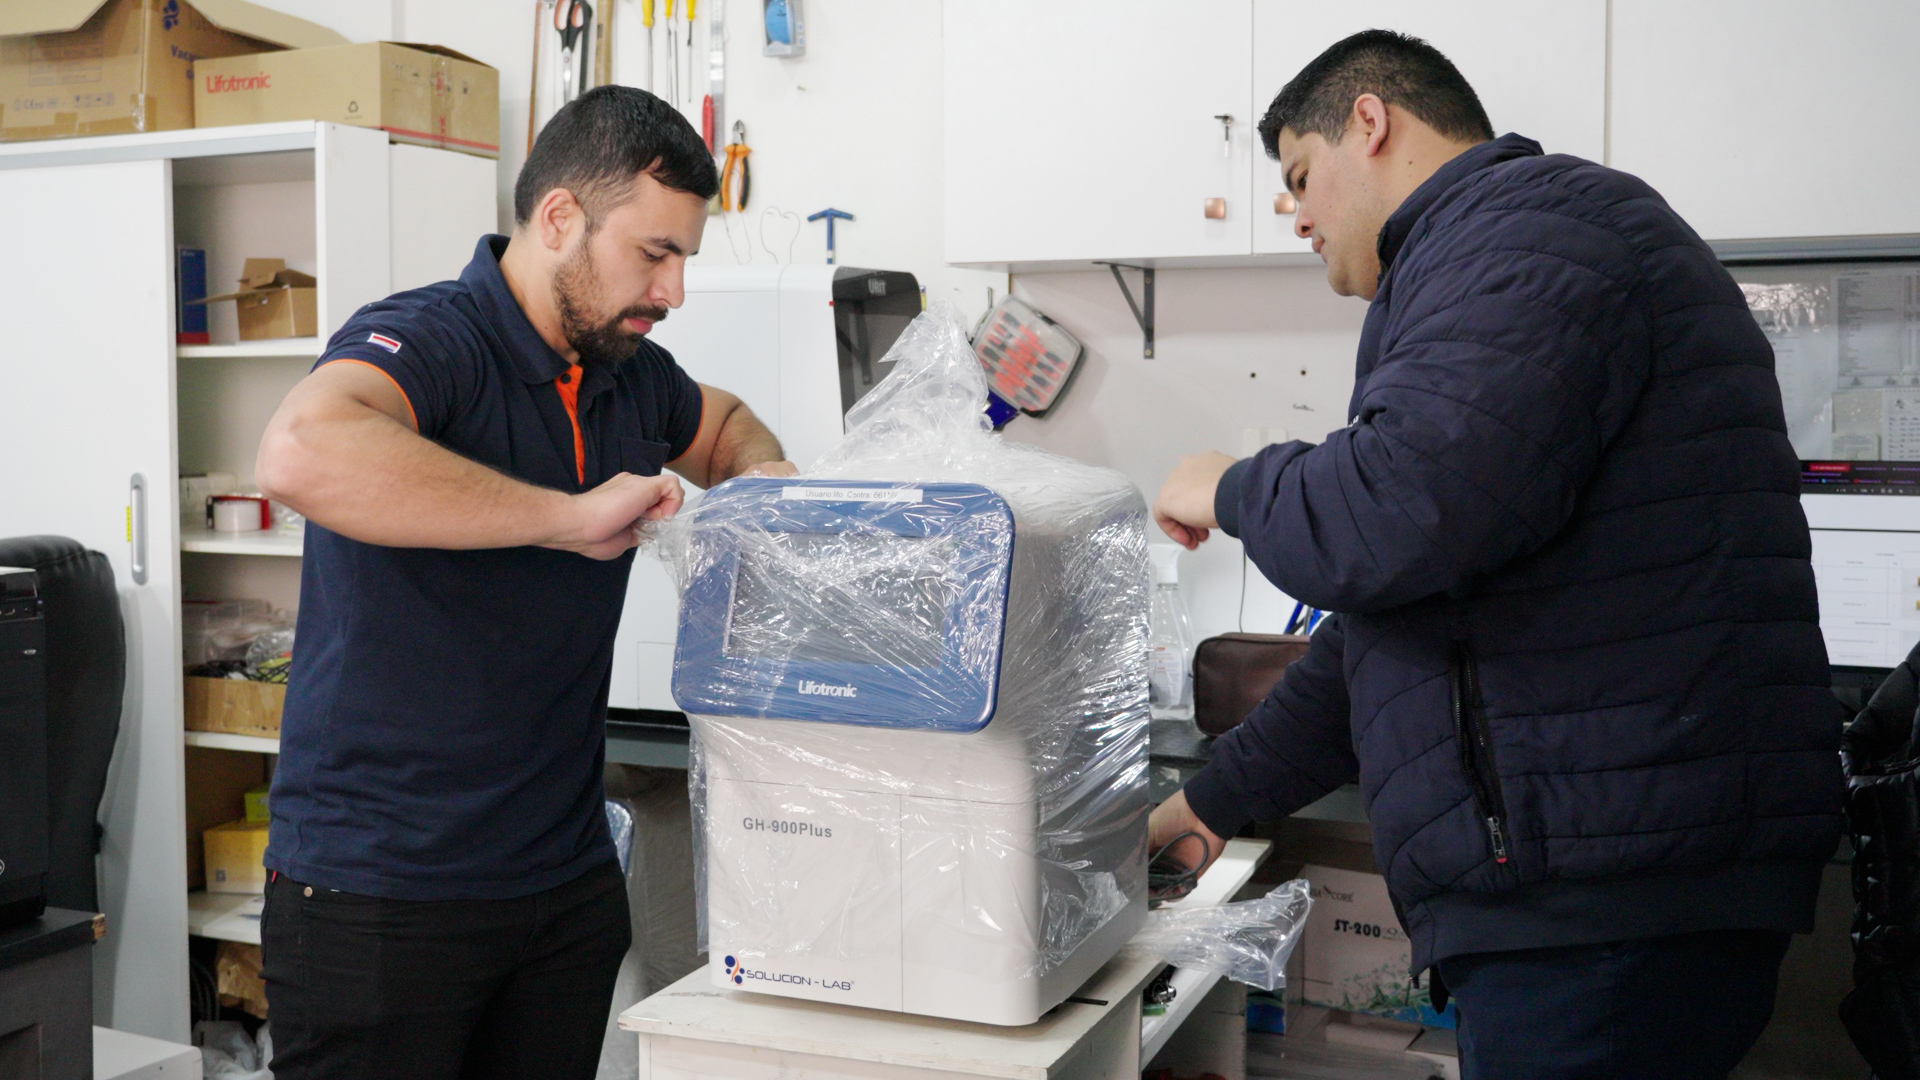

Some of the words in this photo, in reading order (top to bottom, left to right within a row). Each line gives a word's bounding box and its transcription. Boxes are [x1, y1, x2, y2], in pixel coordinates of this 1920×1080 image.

[206, 71, 271, 94] Lifotronic
[868, 278, 886, 297] URIT
[798, 679, 857, 698] Lifotronic
[742, 817, 832, 838] GH-900Plus
[1334, 918, 1381, 938] ST-200
[746, 969, 811, 986] SOLUCION
